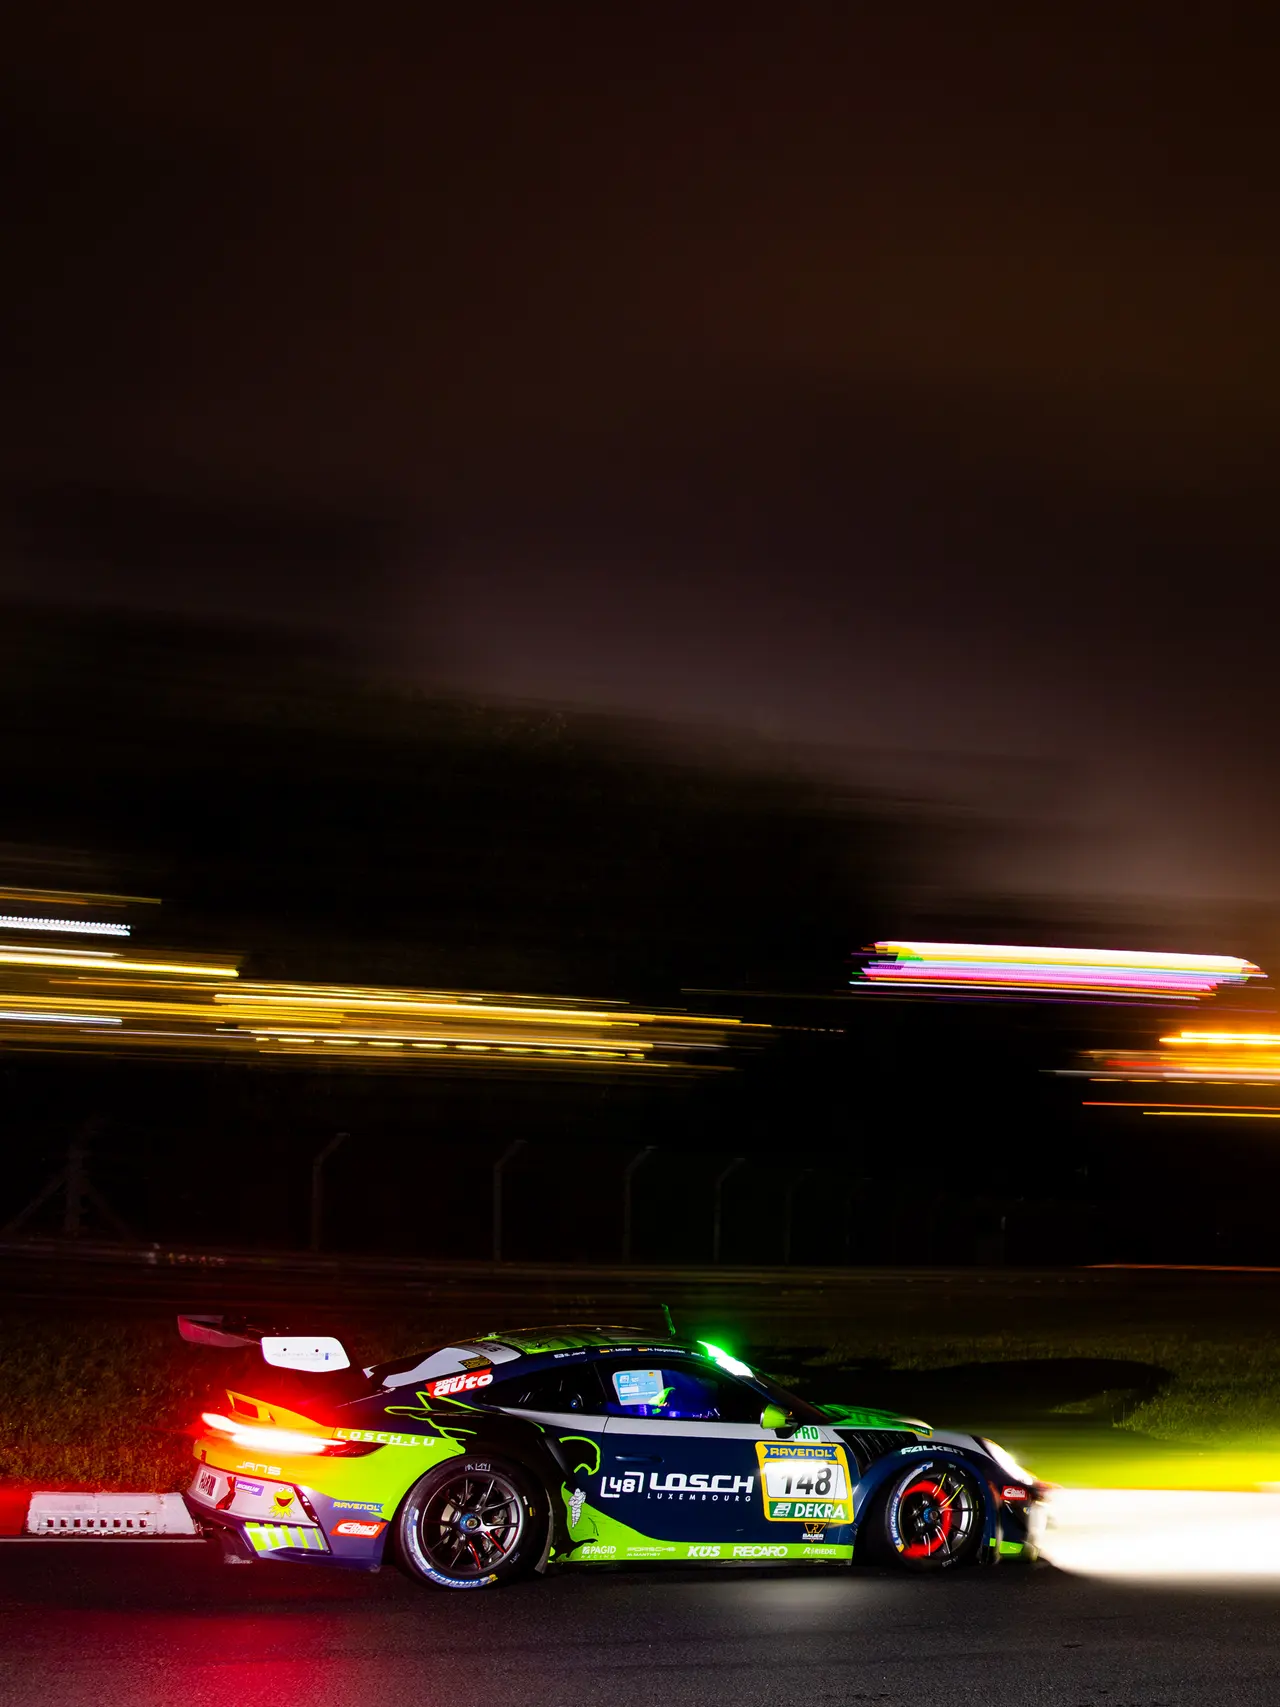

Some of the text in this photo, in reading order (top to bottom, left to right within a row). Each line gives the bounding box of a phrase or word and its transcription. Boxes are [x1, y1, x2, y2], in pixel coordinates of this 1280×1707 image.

[433, 1374, 493, 1396] auto
[435, 1374, 467, 1387] sport
[337, 1430, 435, 1446] LOSCH.LU
[794, 1427, 819, 1440] PRO
[770, 1447, 832, 1457] RAVENOL
[901, 1445, 964, 1456] FALKEN
[649, 1472, 755, 1494] LOSCH
[781, 1467, 832, 1496] 148
[648, 1493, 751, 1502] LUXEMBOURG
[333, 1501, 380, 1511] RAVENOL
[794, 1503, 845, 1519] DEKRA
[590, 1546, 617, 1554] PAGID
[687, 1545, 721, 1557] KÜS
[733, 1545, 788, 1557] RECARO
